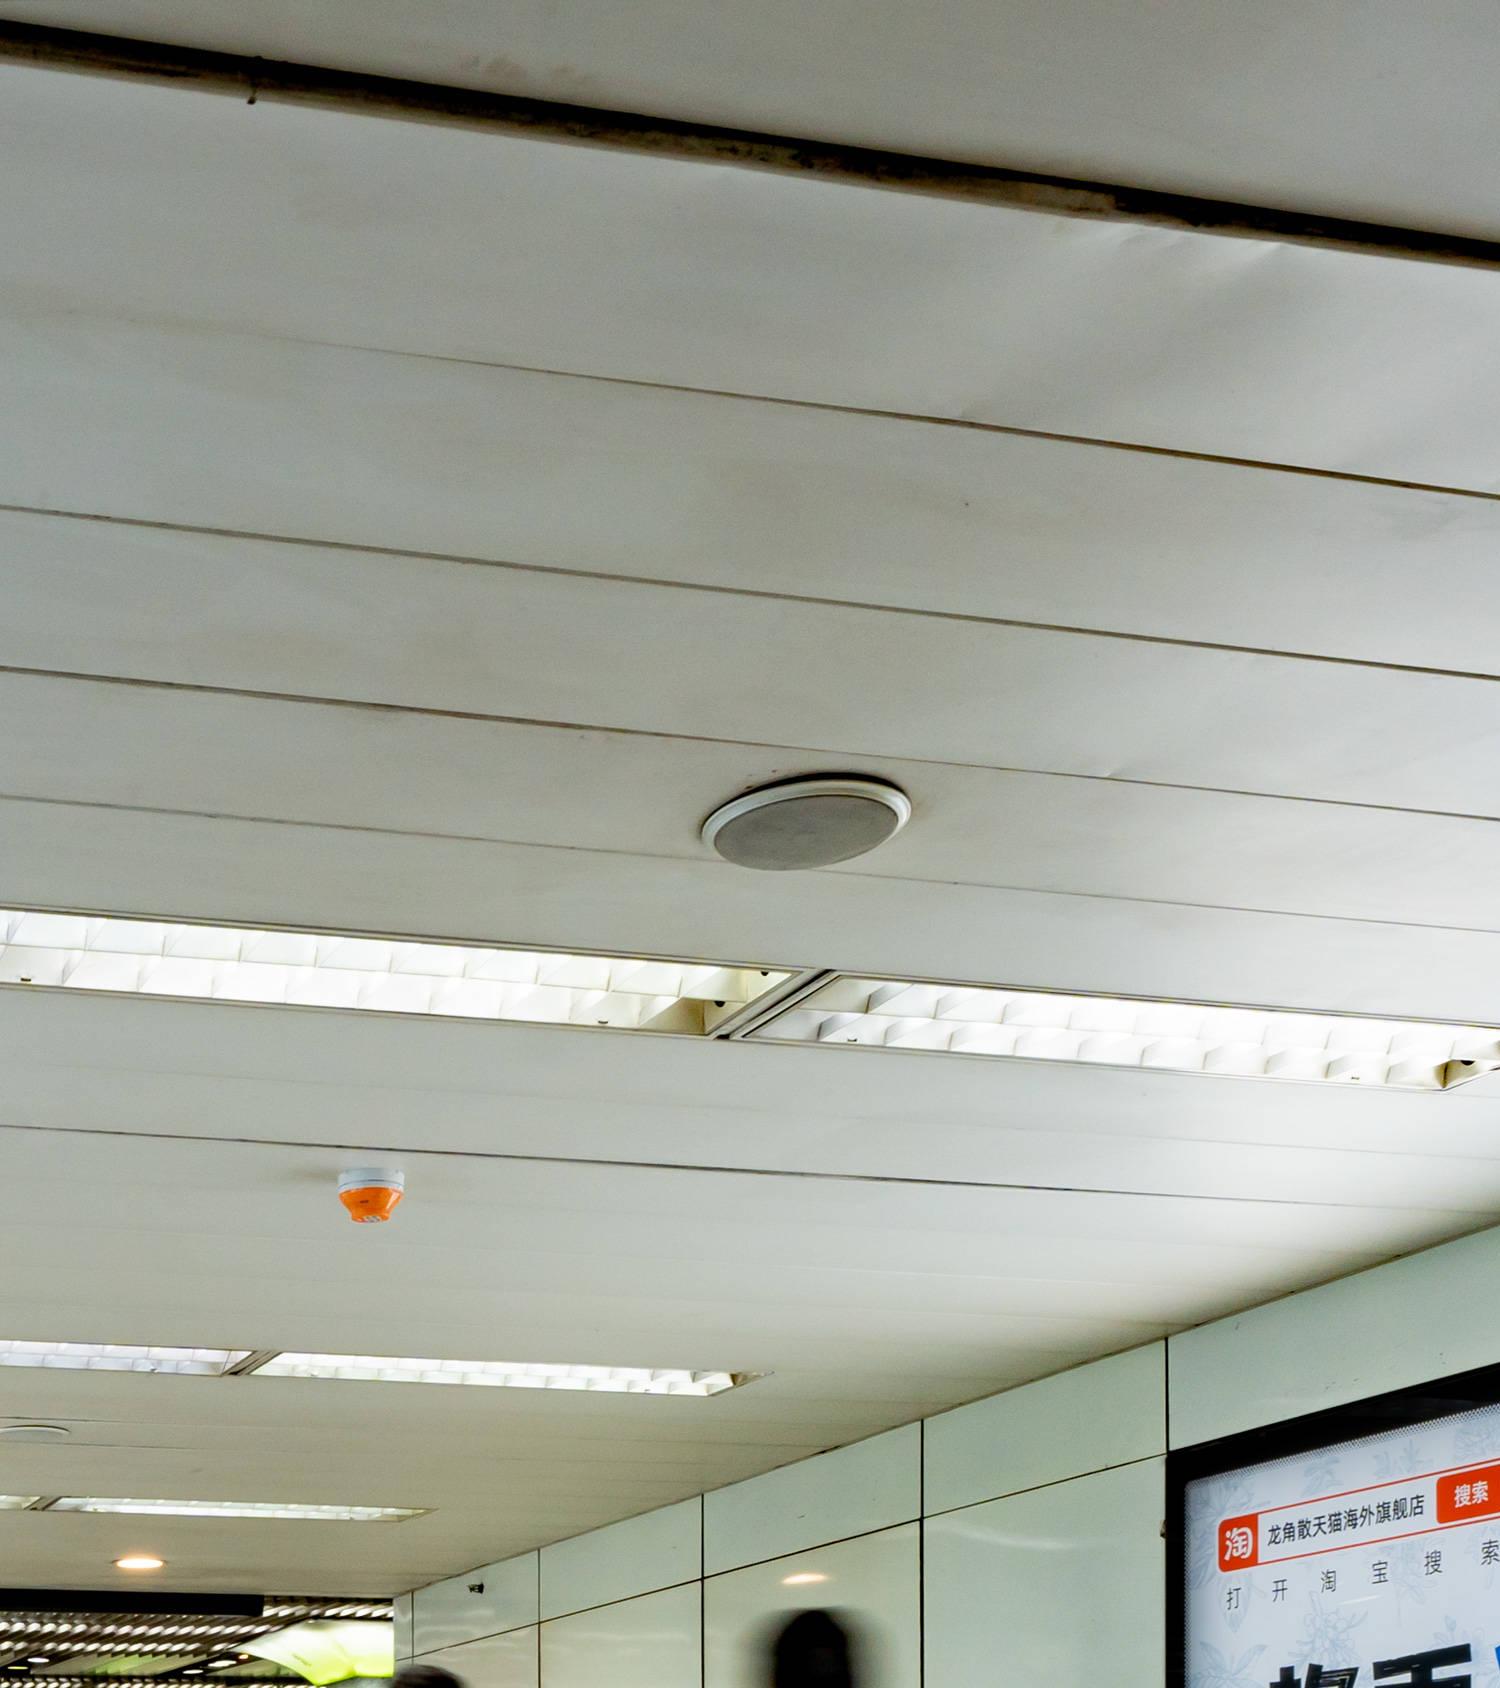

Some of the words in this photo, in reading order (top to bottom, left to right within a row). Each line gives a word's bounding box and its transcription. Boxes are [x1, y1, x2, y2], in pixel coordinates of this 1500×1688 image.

[1454, 1480, 1490, 1509] 搜索
[1267, 1494, 1425, 1547] 龙角散天猫海外旗舰店
[1224, 1527, 1253, 1561] 淘
